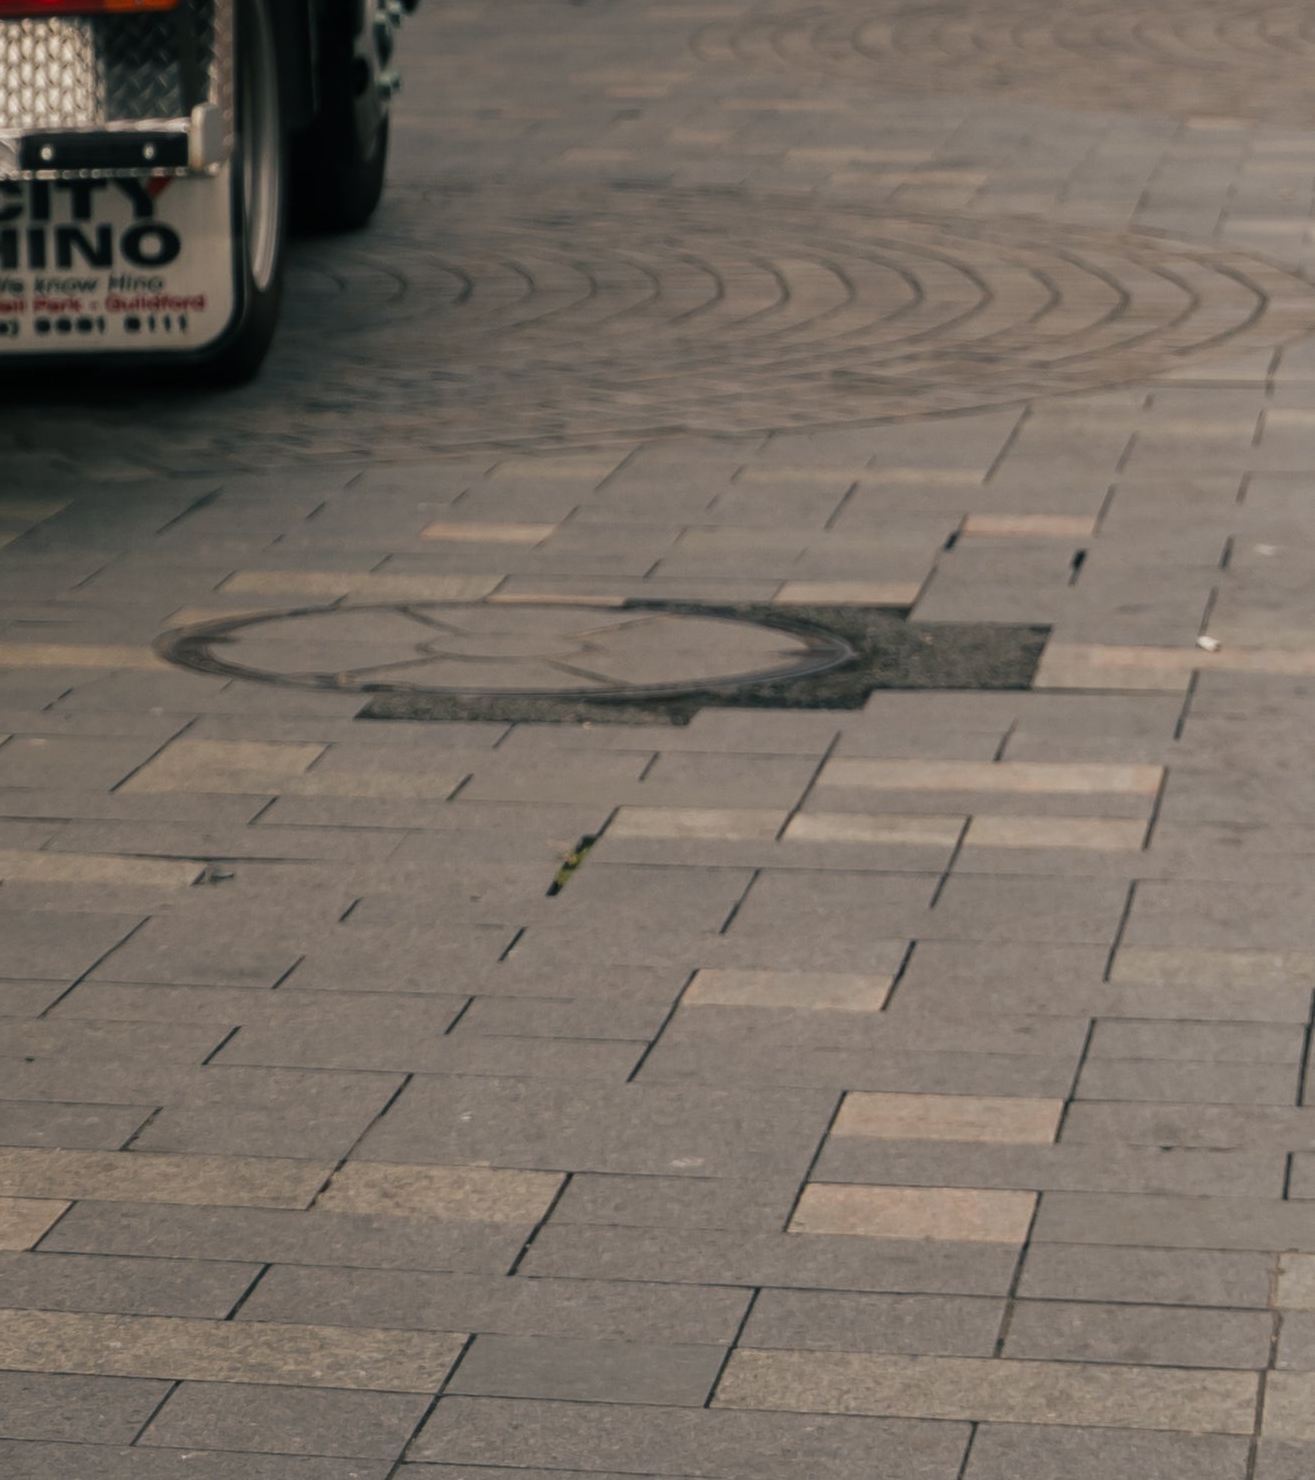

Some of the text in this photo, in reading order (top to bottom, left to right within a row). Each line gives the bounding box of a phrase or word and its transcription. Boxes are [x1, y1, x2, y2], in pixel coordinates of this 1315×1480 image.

[34, 274, 99, 295] know
[108, 272, 165, 293] Hino
[33, 296, 81, 314] Park
[105, 293, 206, 313] Guildford
